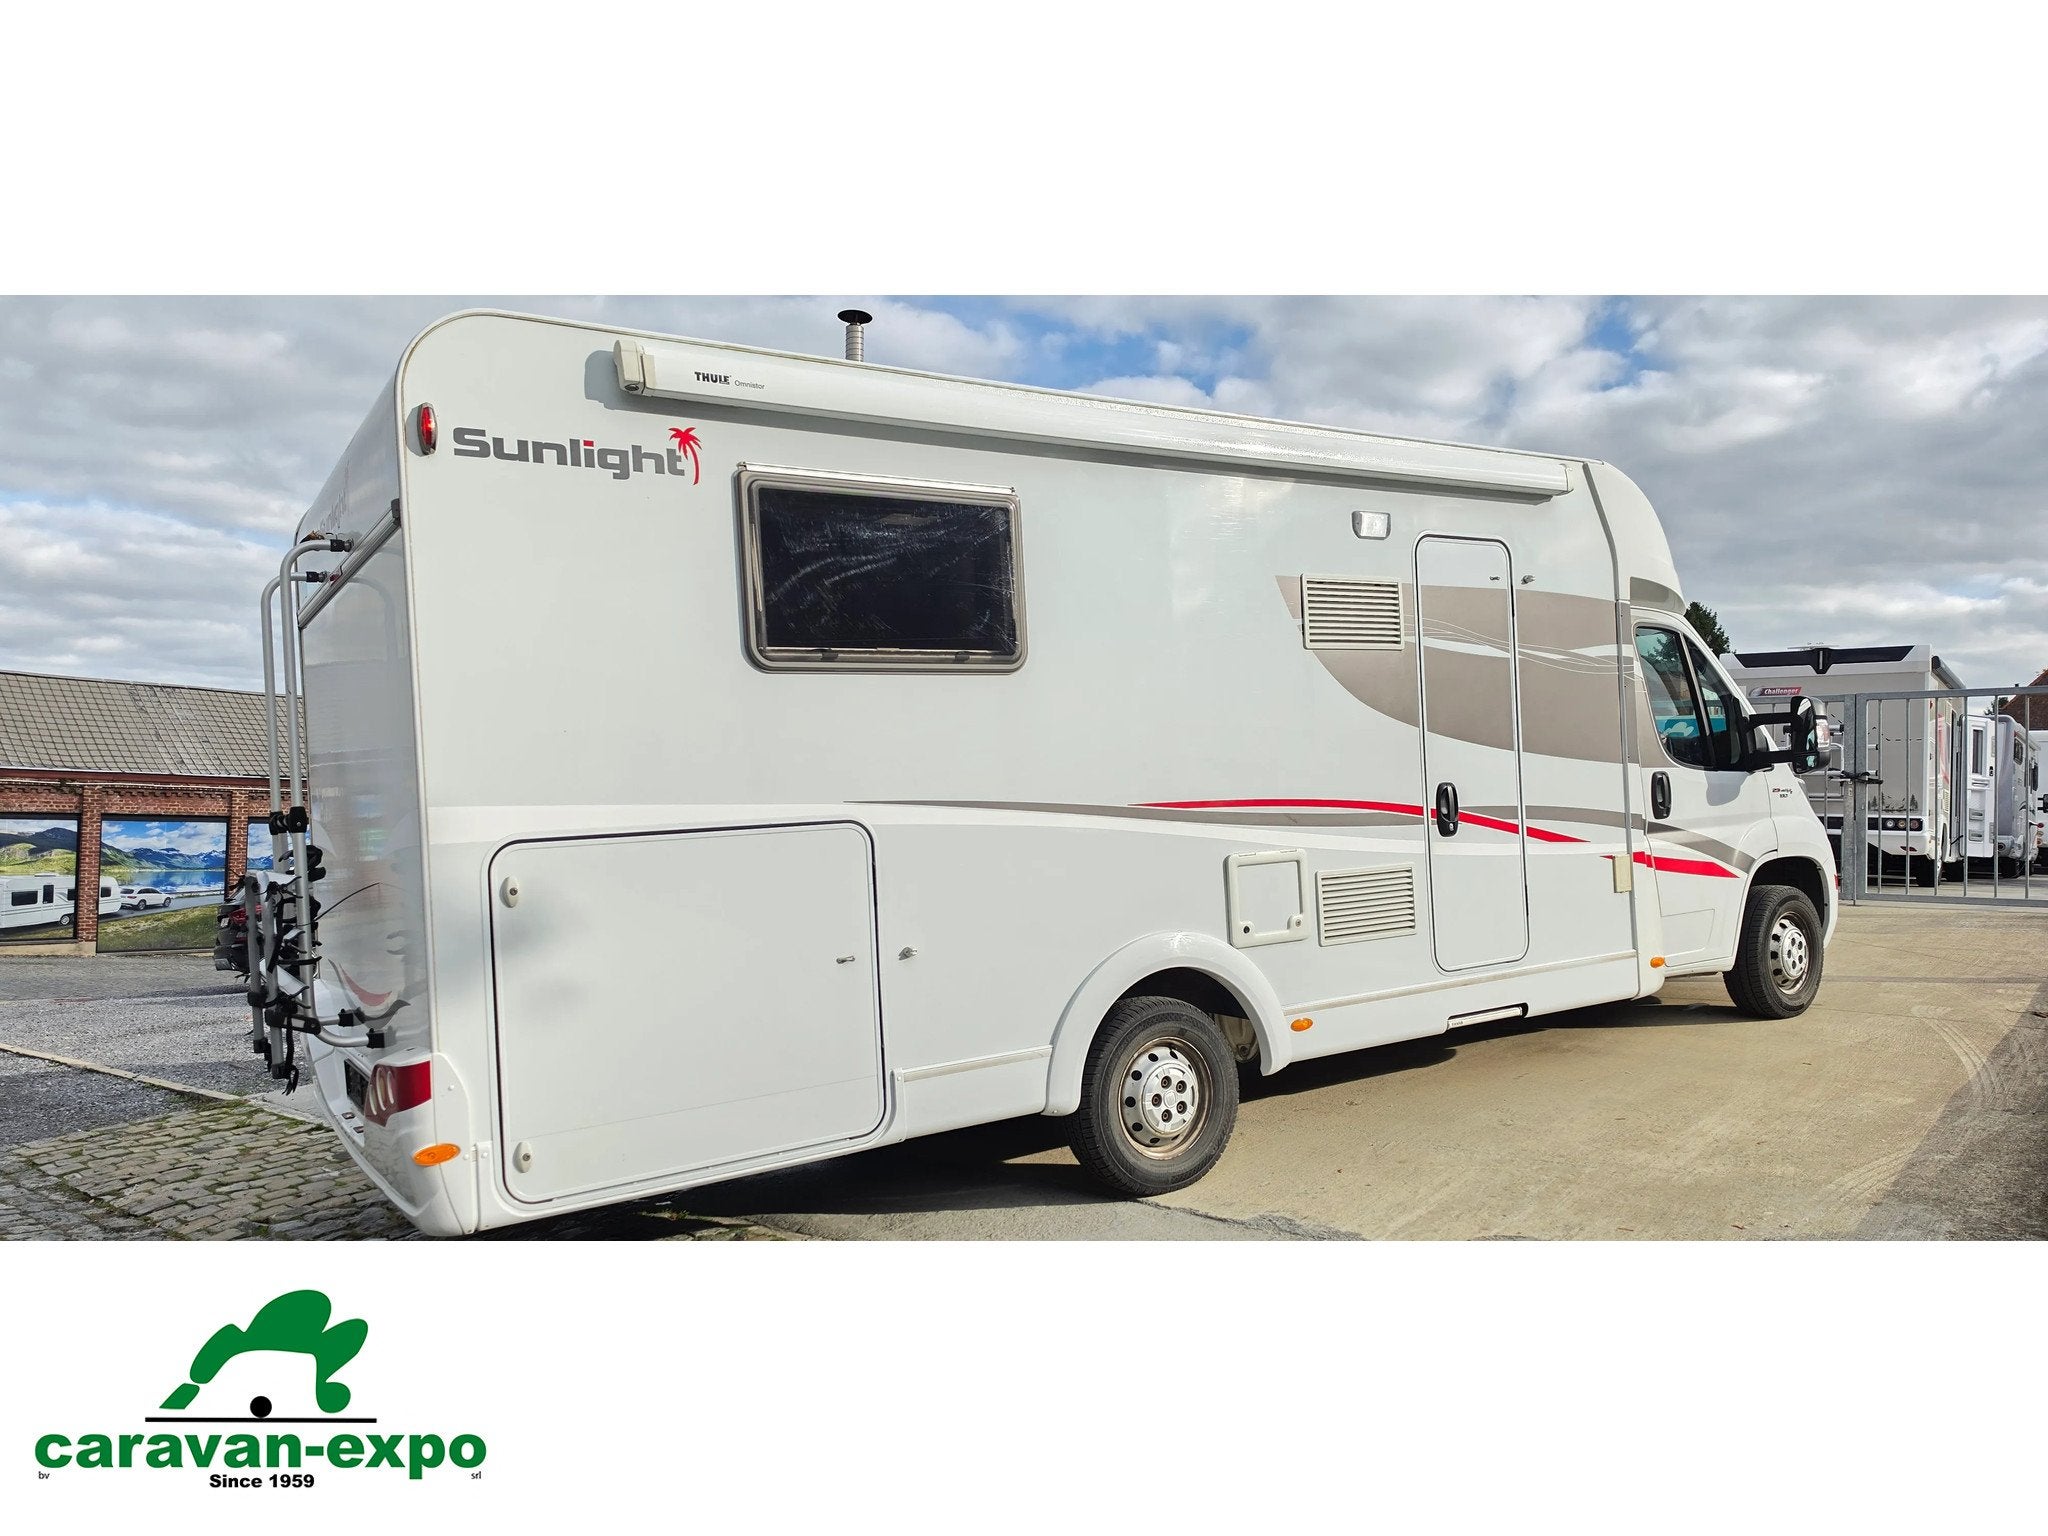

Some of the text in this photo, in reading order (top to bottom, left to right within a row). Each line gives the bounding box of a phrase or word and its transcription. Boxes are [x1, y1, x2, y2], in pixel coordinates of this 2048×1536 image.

[694, 371, 765, 389] THULE Omnistor
[453, 427, 685, 480] Sunlight
